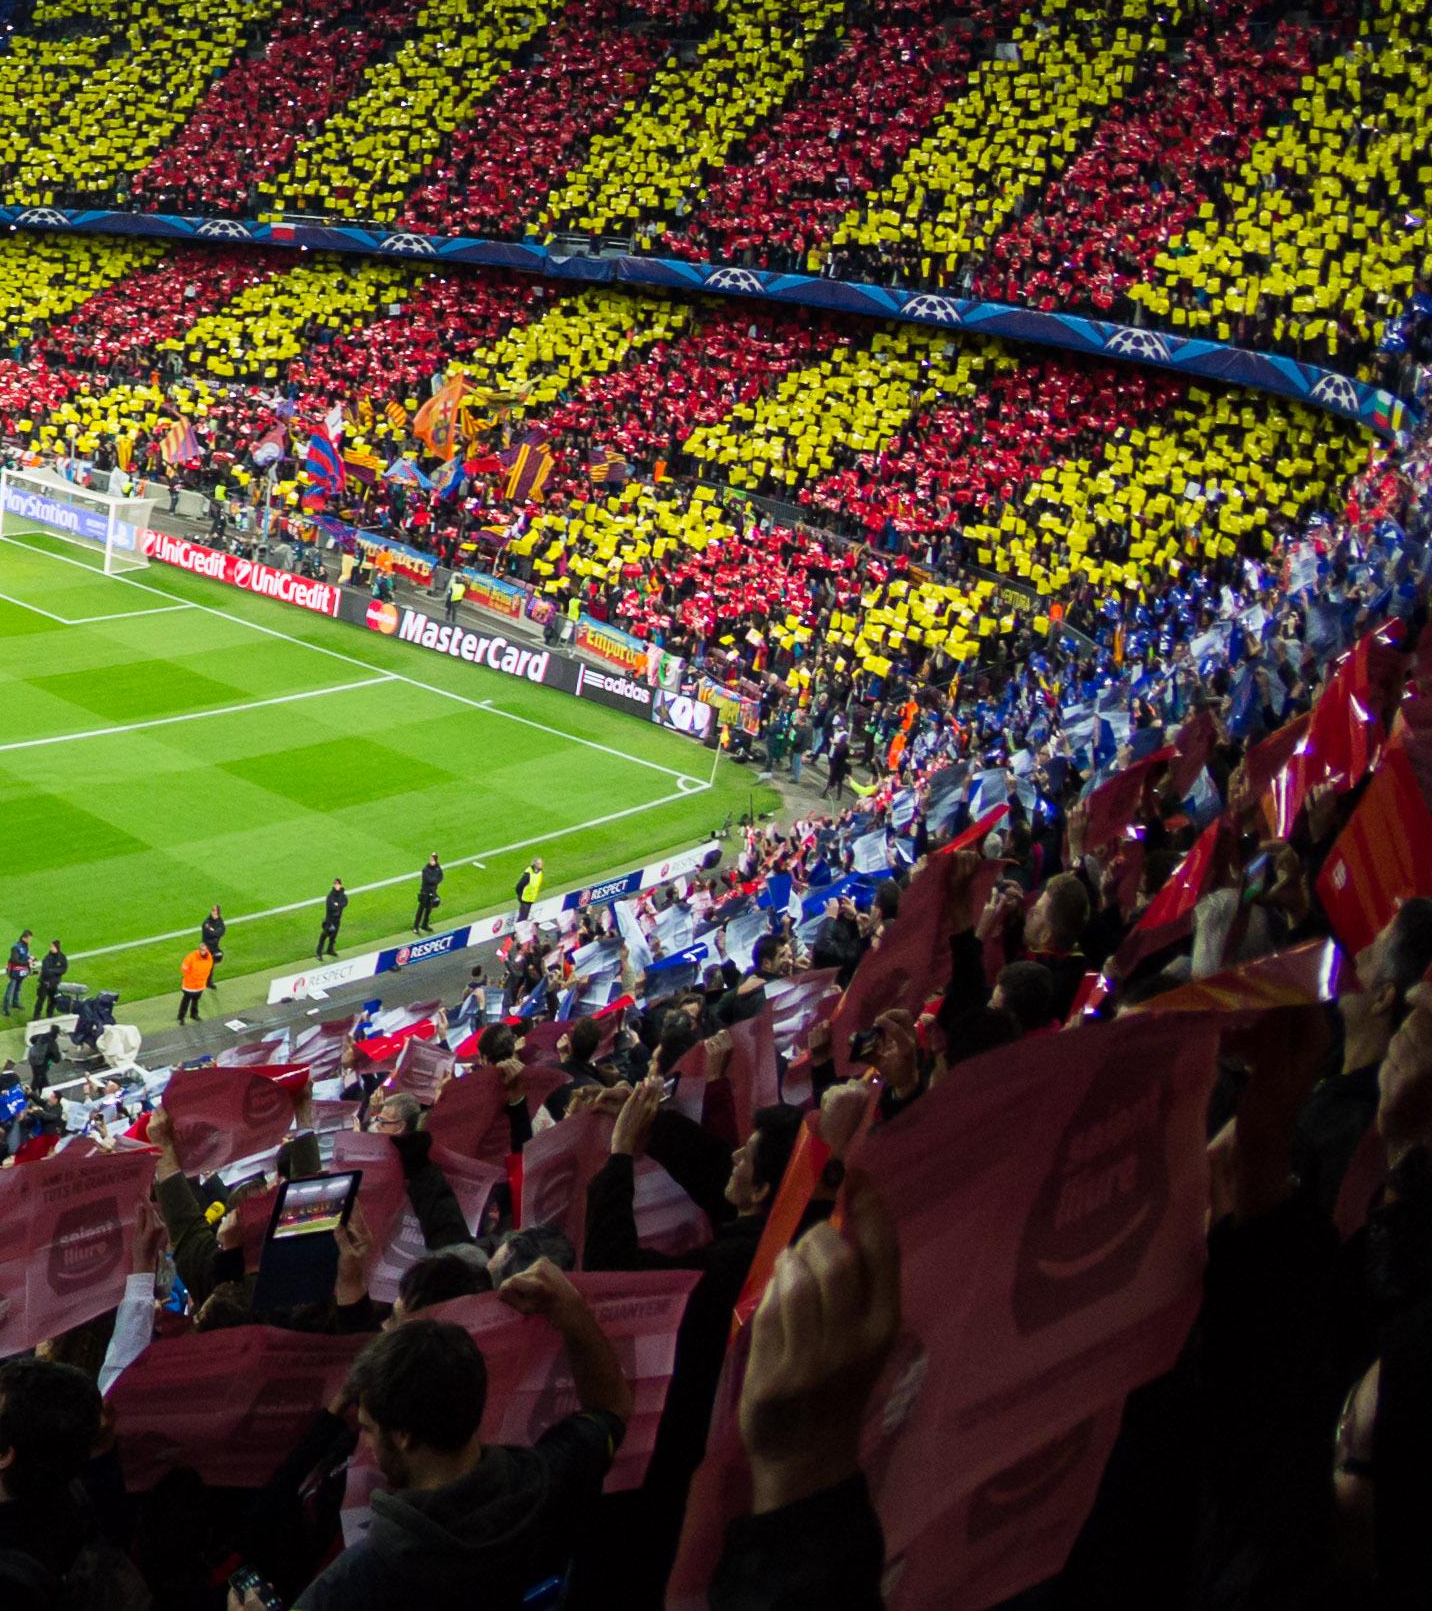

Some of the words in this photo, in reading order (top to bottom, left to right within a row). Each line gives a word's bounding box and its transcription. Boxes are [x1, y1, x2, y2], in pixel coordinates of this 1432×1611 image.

[156, 538, 227, 580] UniCredit
[251, 565, 331, 614] UniCredit
[398, 609, 551, 683] MasterCard
[604, 677, 650, 704] adidas
[591, 878, 630, 901] RESPECT
[409, 935, 454, 962] RESPECT
[308, 965, 355, 986] RESPECT
[59, 1220, 115, 1245] seient
[64, 1244, 108, 1266] lliure
